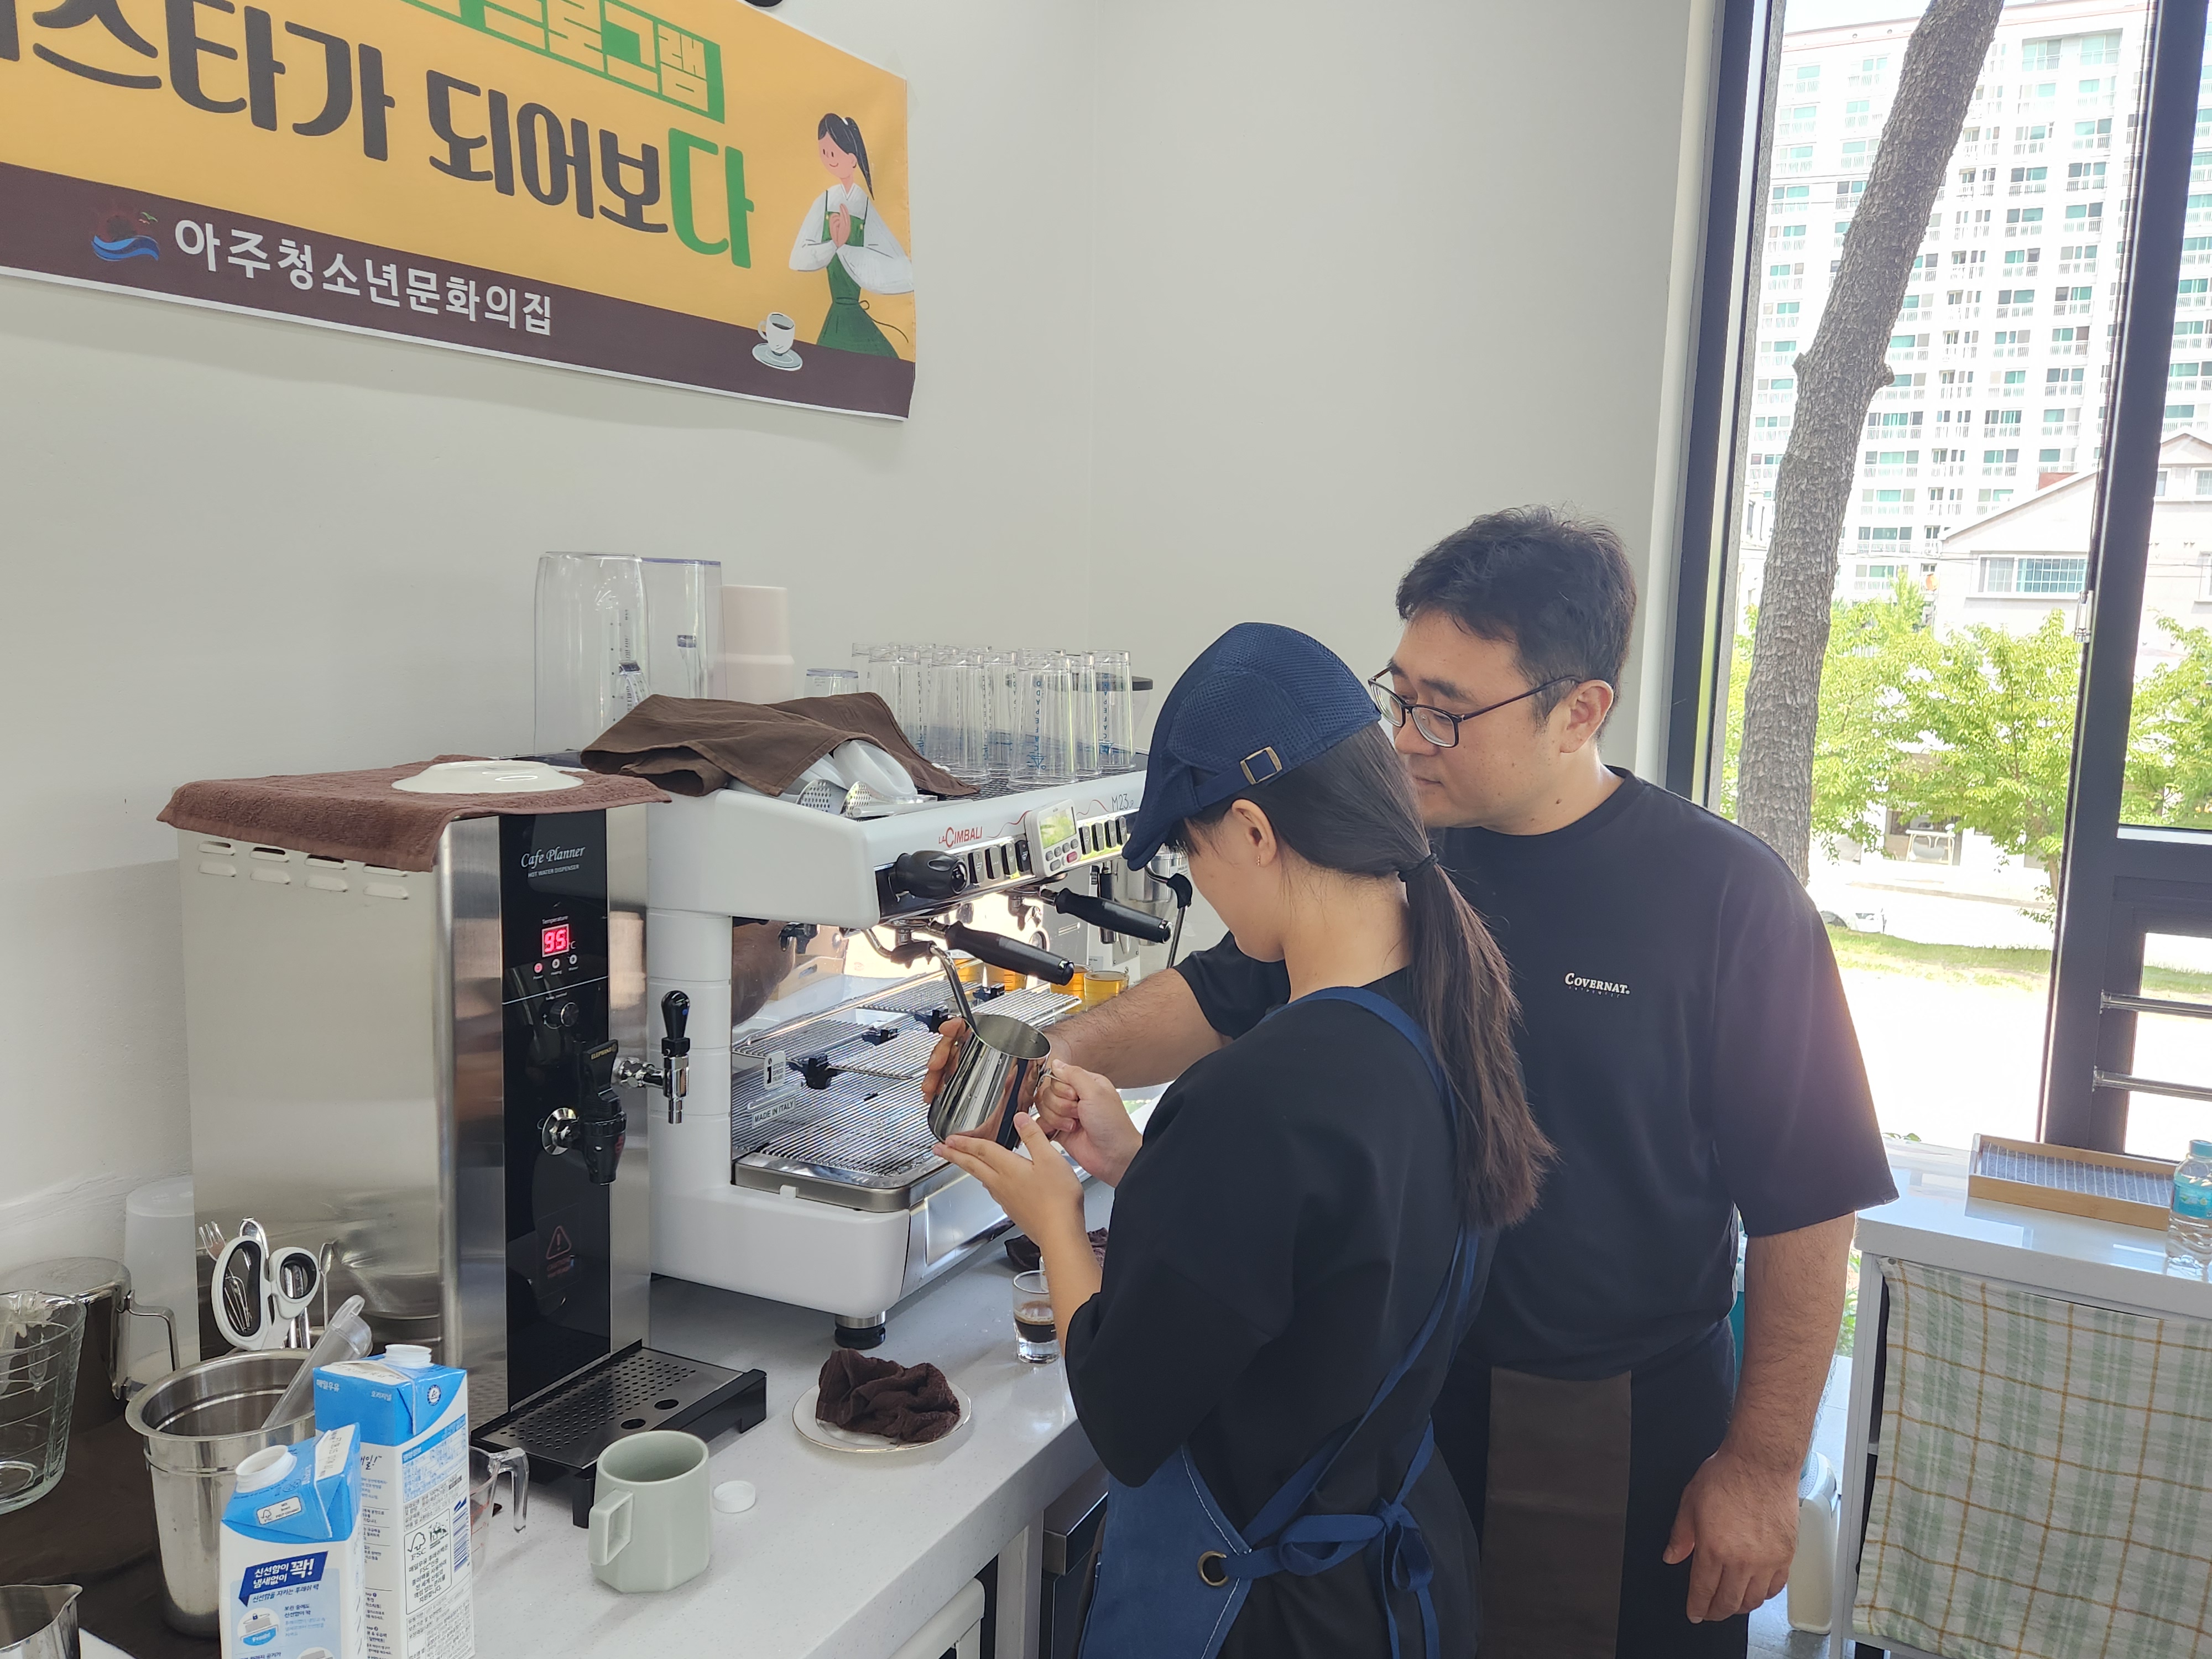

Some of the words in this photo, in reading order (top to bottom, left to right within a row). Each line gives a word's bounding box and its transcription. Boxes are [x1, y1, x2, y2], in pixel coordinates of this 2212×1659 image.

[0, 0, 395, 161] 스타가
[426, 69, 755, 269] 되어보다
[175, 219, 551, 336] 아주청소년문화의집
[945, 826, 983, 848] CIMBALI
[521, 849, 544, 869] Cafe
[546, 846, 585, 863] Planner
[538, 868, 554, 877] WATER
[554, 864, 580, 873] DISPENSER
[754, 1111, 771, 1123] MADE
[772, 1107, 778, 1116] IN
[779, 1100, 794, 1113] ITALY
[411, 1548, 426, 1561] FSC
[254, 1563, 289, 1578] 신선함이
[290, 1558, 315, 1578] 꽉!
[253, 1573, 288, 1589] 냄새없이
[253, 1592, 275, 1603] 신선함을
[276, 1588, 294, 1598] 지키는
